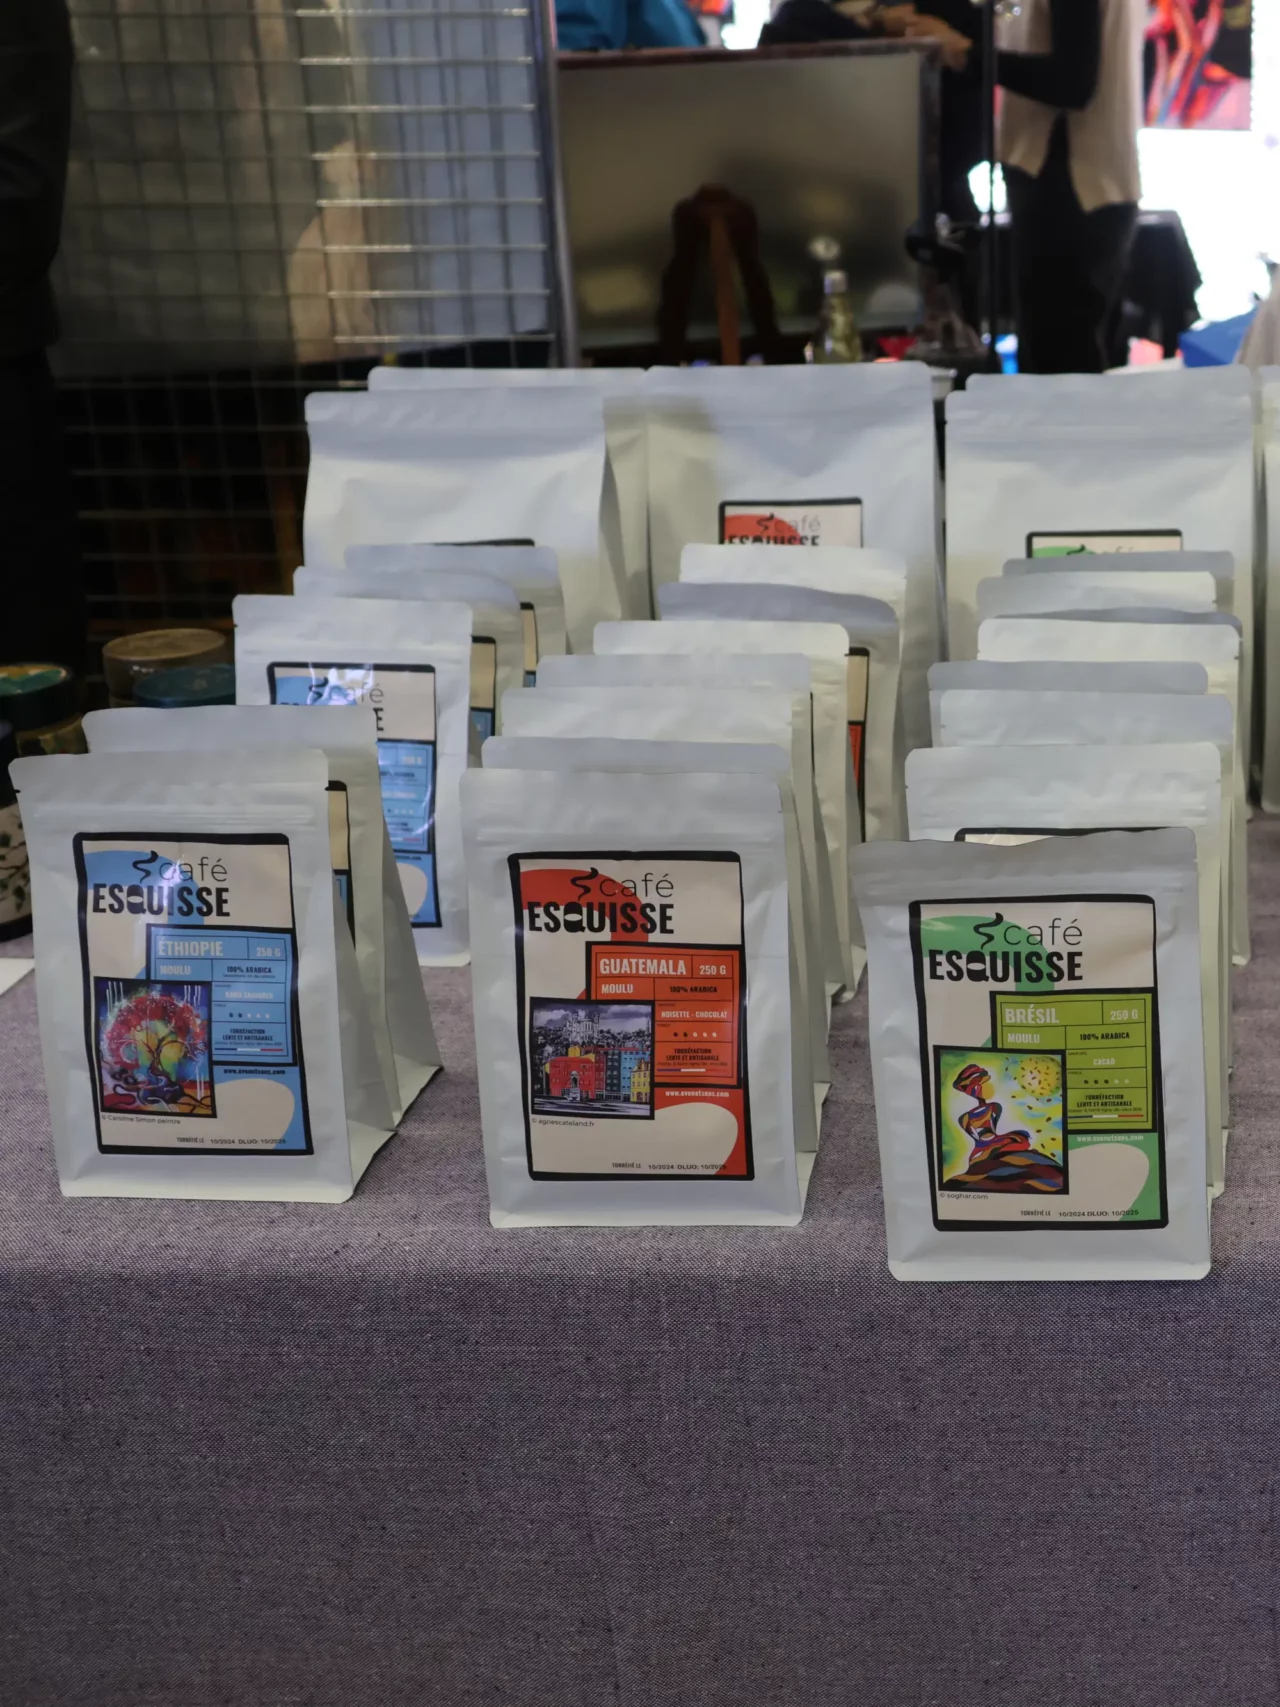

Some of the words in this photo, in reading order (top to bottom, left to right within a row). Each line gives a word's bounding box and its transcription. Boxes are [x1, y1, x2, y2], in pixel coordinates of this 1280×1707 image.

[774, 515, 821, 533] café
[158, 856, 228, 883] café
[599, 872, 674, 898] café
[92, 883, 231, 918] ESQUISSE
[527, 901, 675, 934] ESQUISSE
[1003, 918, 1083, 946] café
[158, 936, 224, 957] ÉTHIOPIE
[159, 964, 191, 976] MOULU
[245, 966, 272, 974] ARABICA
[600, 957, 687, 976] GUATEMALA
[699, 965, 717, 975] 250
[719, 965, 727, 975] G
[929, 949, 1083, 984] ESQUISSE
[601, 983, 634, 994] MOULU
[669, 985, 688, 993] 100%
[689, 985, 718, 993] ARABICA
[695, 1011, 728, 1019] CHOCOLAT
[1005, 1005, 1059, 1024] BRÉSIL
[1110, 1010, 1129, 1021] 250
[1131, 1009, 1138, 1020] G
[1007, 1032, 1040, 1044] MOULU
[1079, 1033, 1099, 1041] 100%
[1100, 1032, 1130, 1040] ARABICA
[107, 1115, 134, 1123] Caroline
[135, 1116, 157, 1124] Simon
[946, 1192, 989, 1200] soghar.com
[1111, 1209, 1139, 1217] 10/2025
